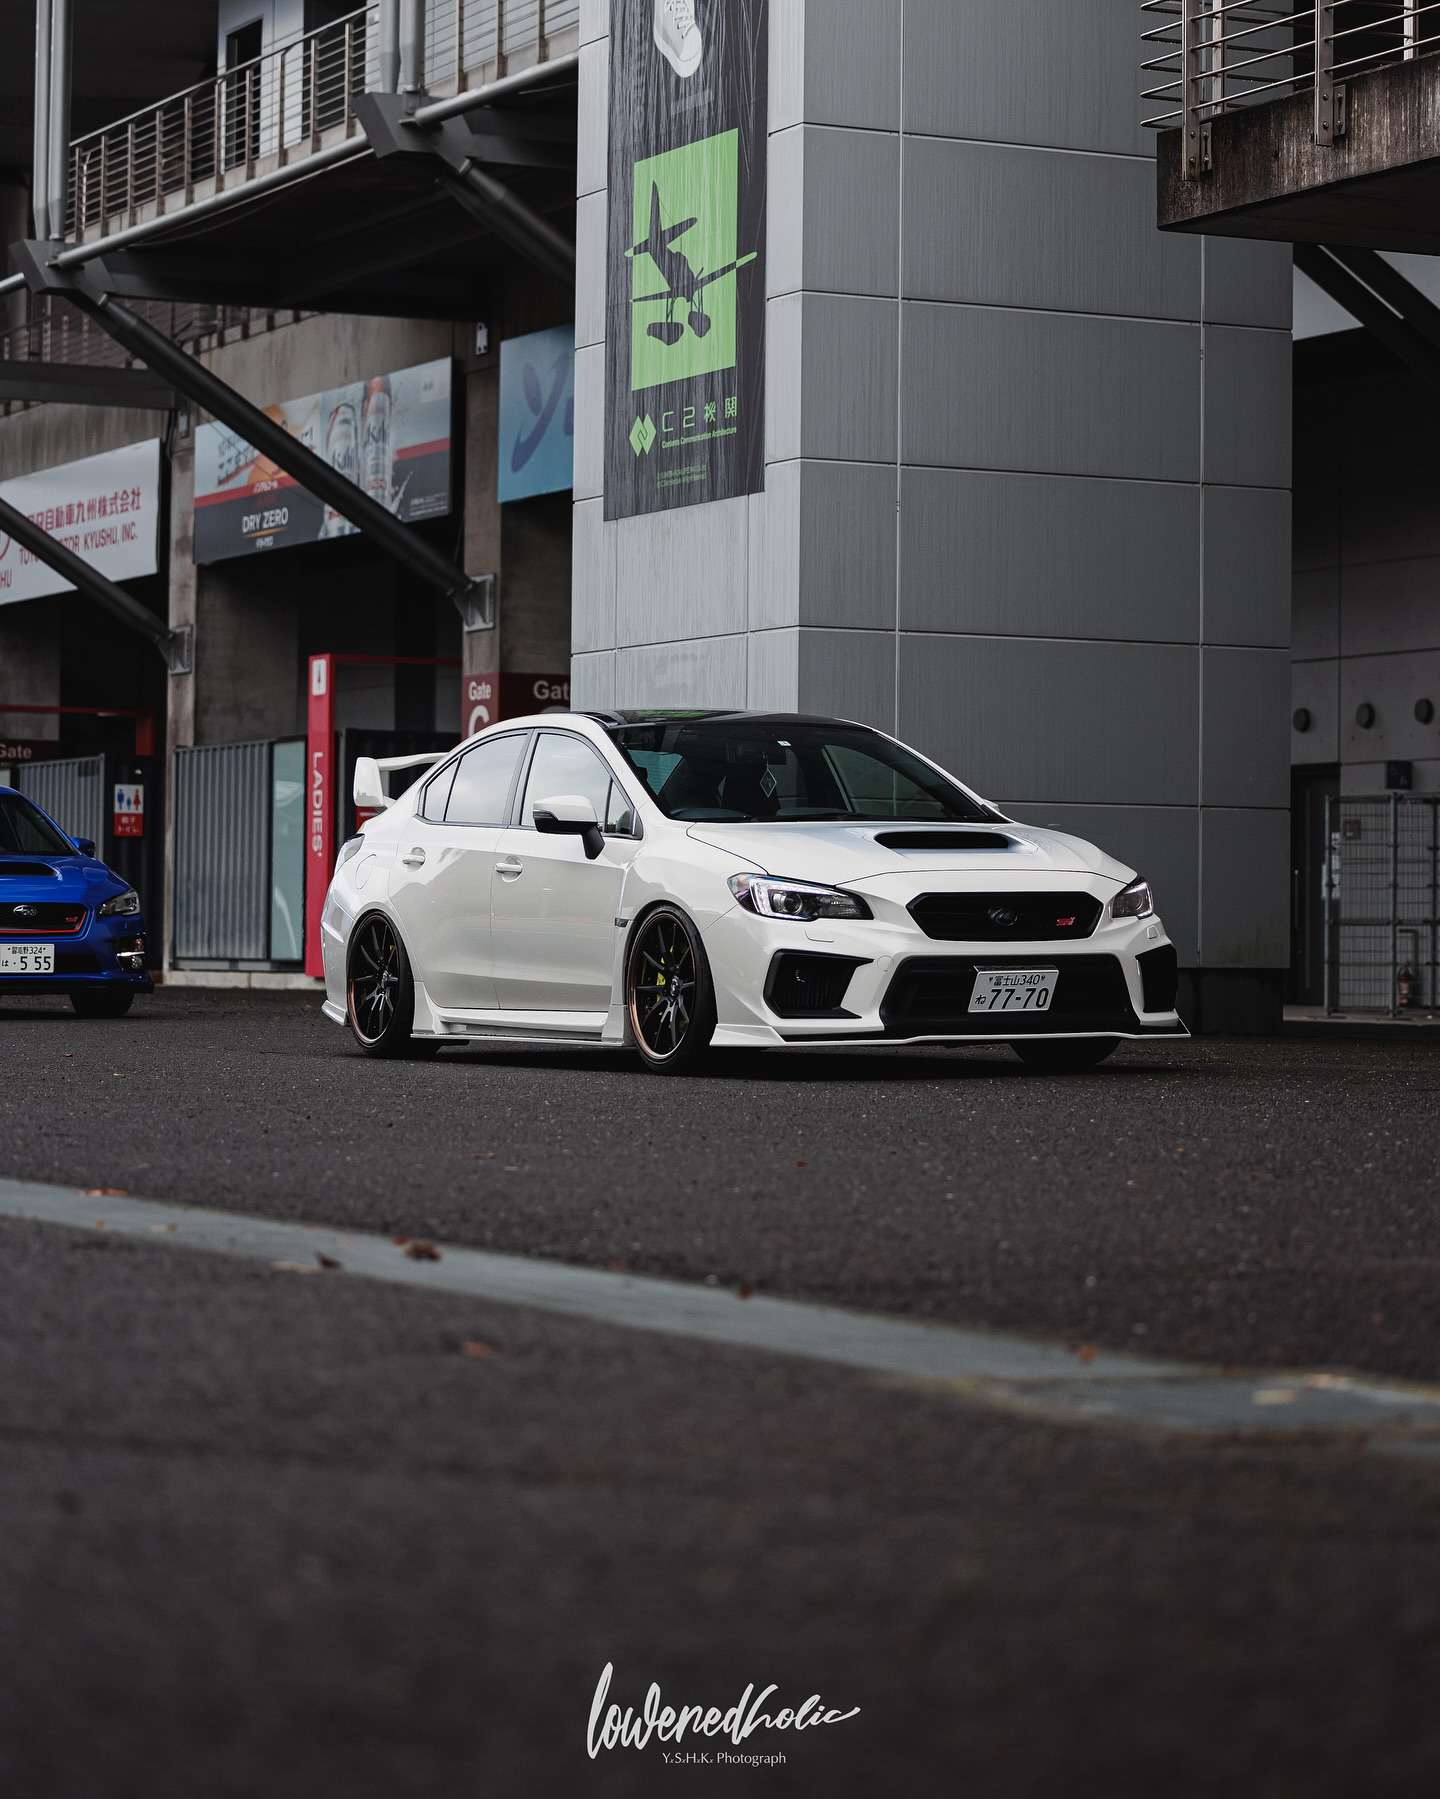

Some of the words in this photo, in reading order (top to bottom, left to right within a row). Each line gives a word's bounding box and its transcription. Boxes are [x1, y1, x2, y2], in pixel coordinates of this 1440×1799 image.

[242, 513, 261, 533] DRY
[262, 507, 289, 529] ZERO
[468, 681, 492, 701] Gate
[533, 680, 570, 699] Gat
[988, 987, 1050, 1010] 77-70
